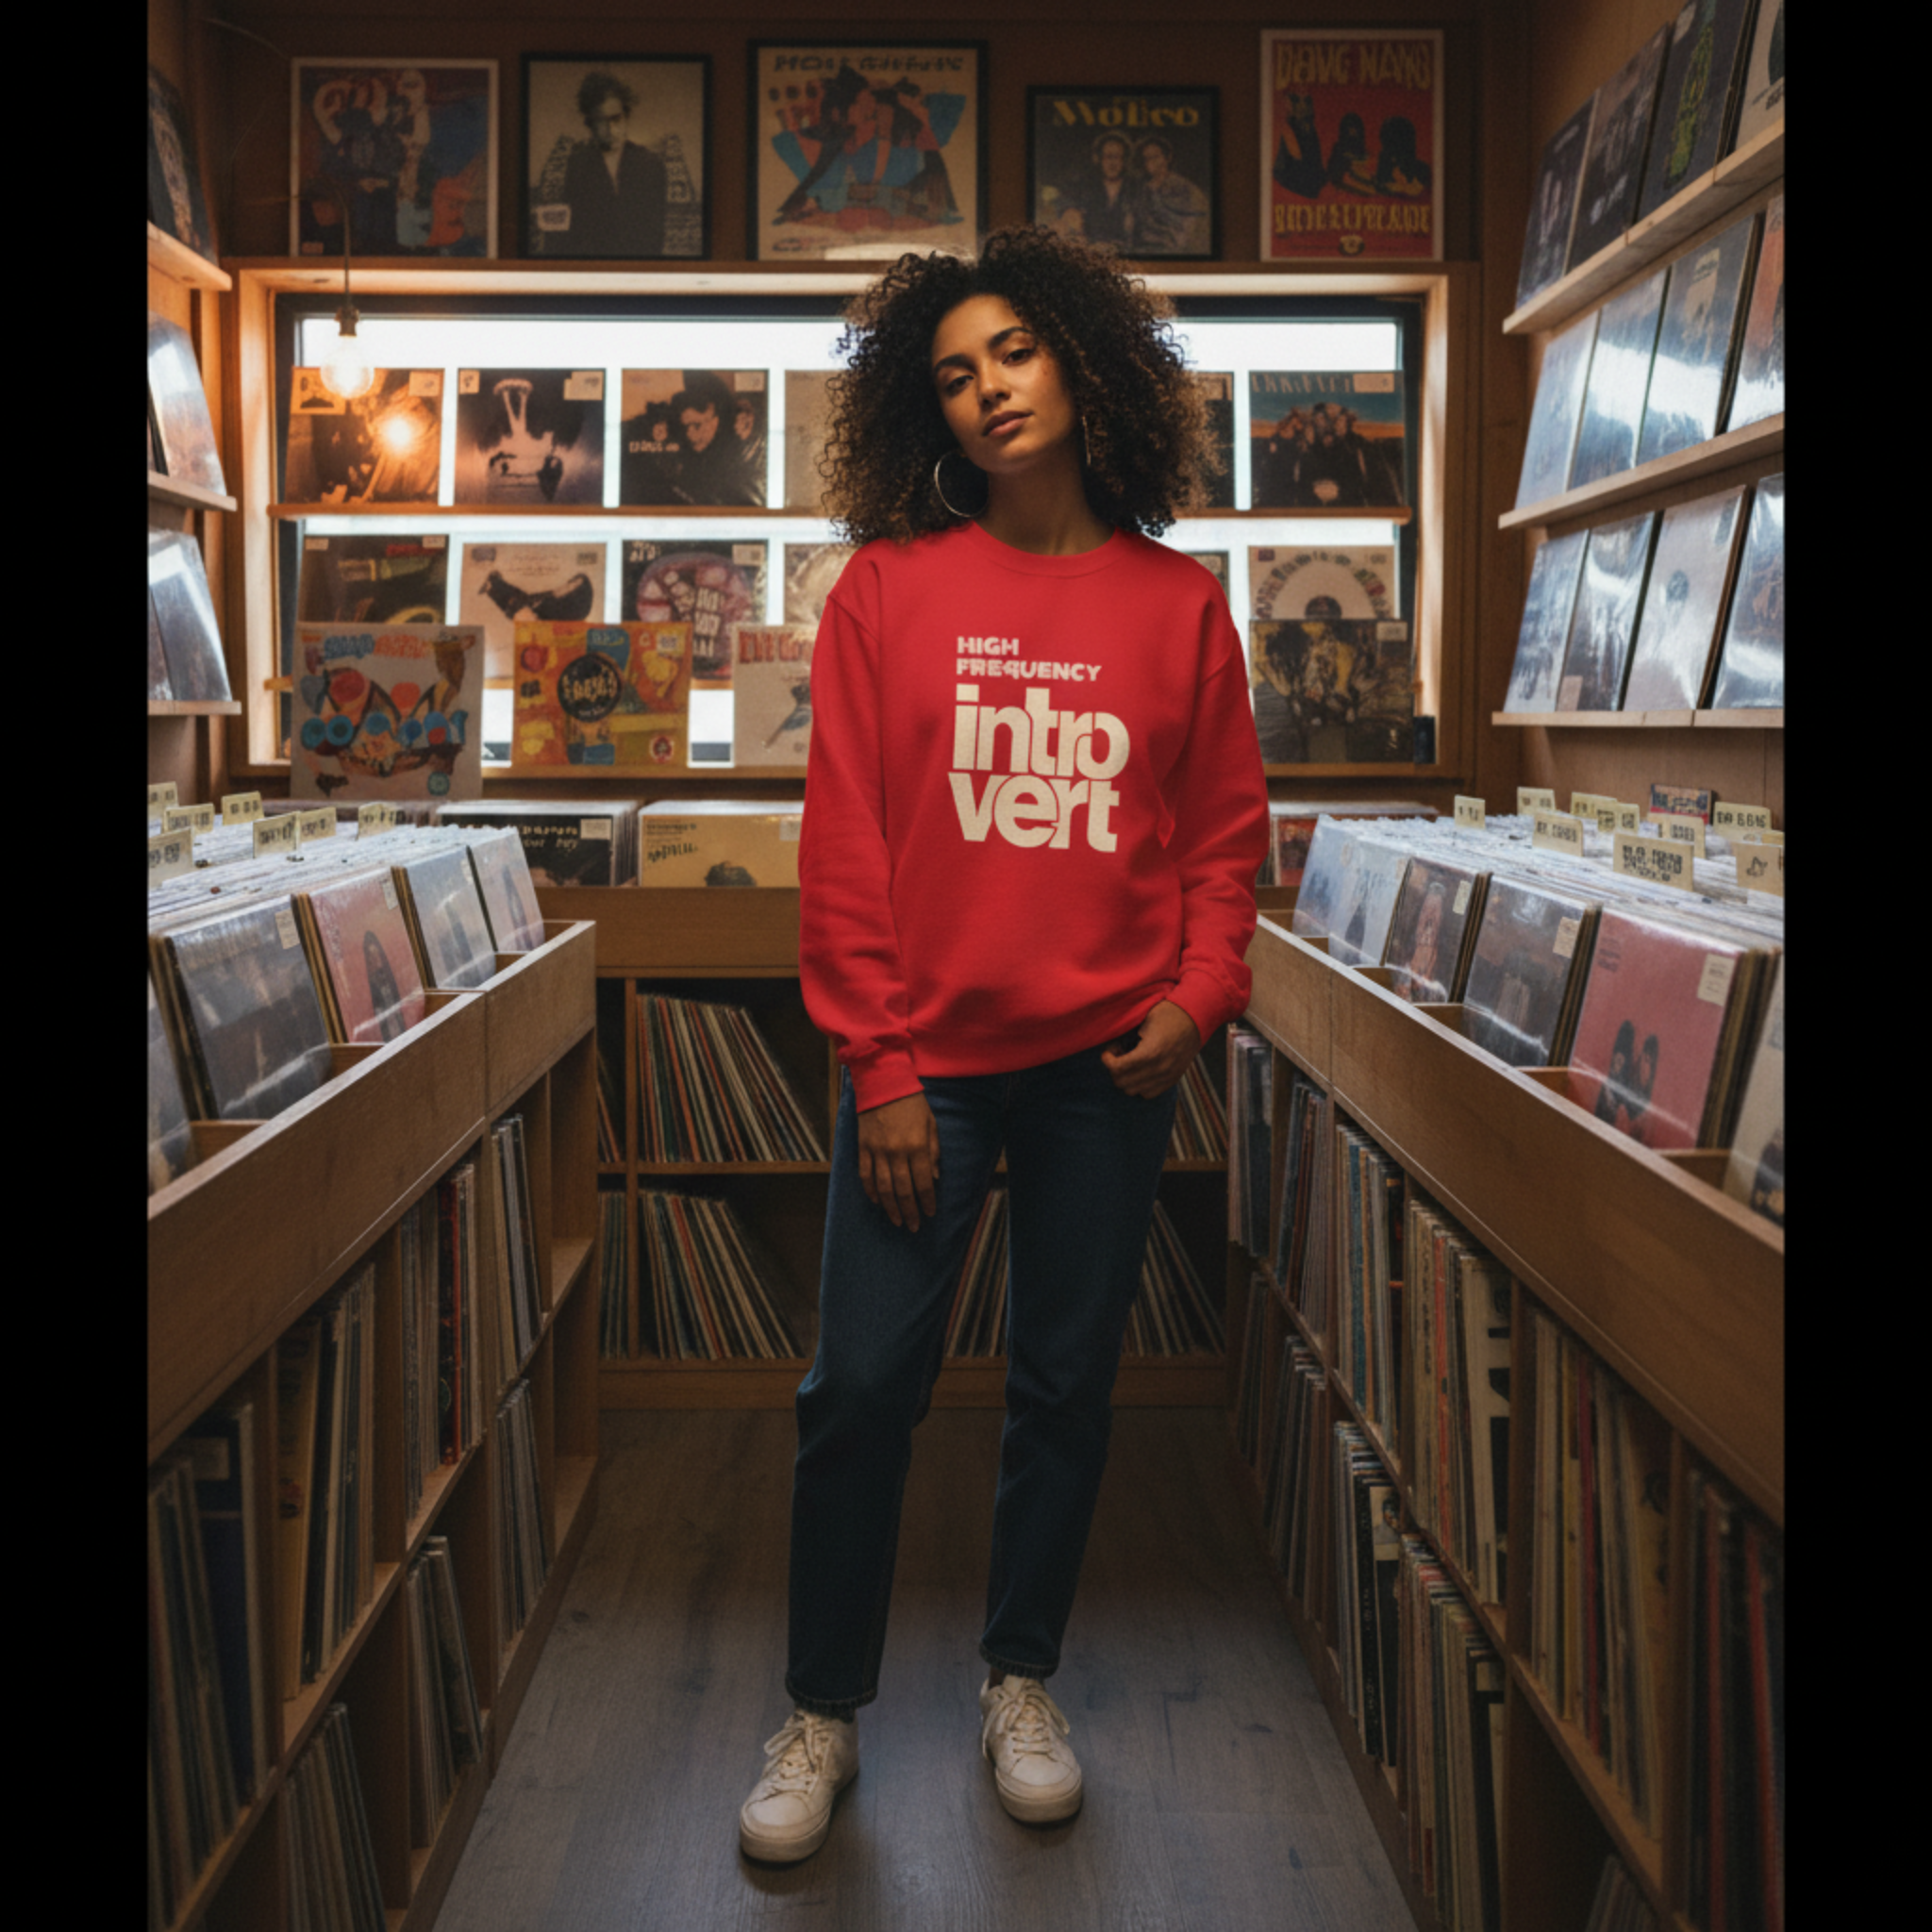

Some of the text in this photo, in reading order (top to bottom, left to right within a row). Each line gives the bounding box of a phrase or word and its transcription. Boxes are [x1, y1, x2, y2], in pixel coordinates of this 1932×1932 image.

[956, 658, 1102, 681] FREQUENCY
[957, 636, 1020, 656] HIGH
[952, 683, 1130, 780] intro
[948, 772, 1120, 853] vert
